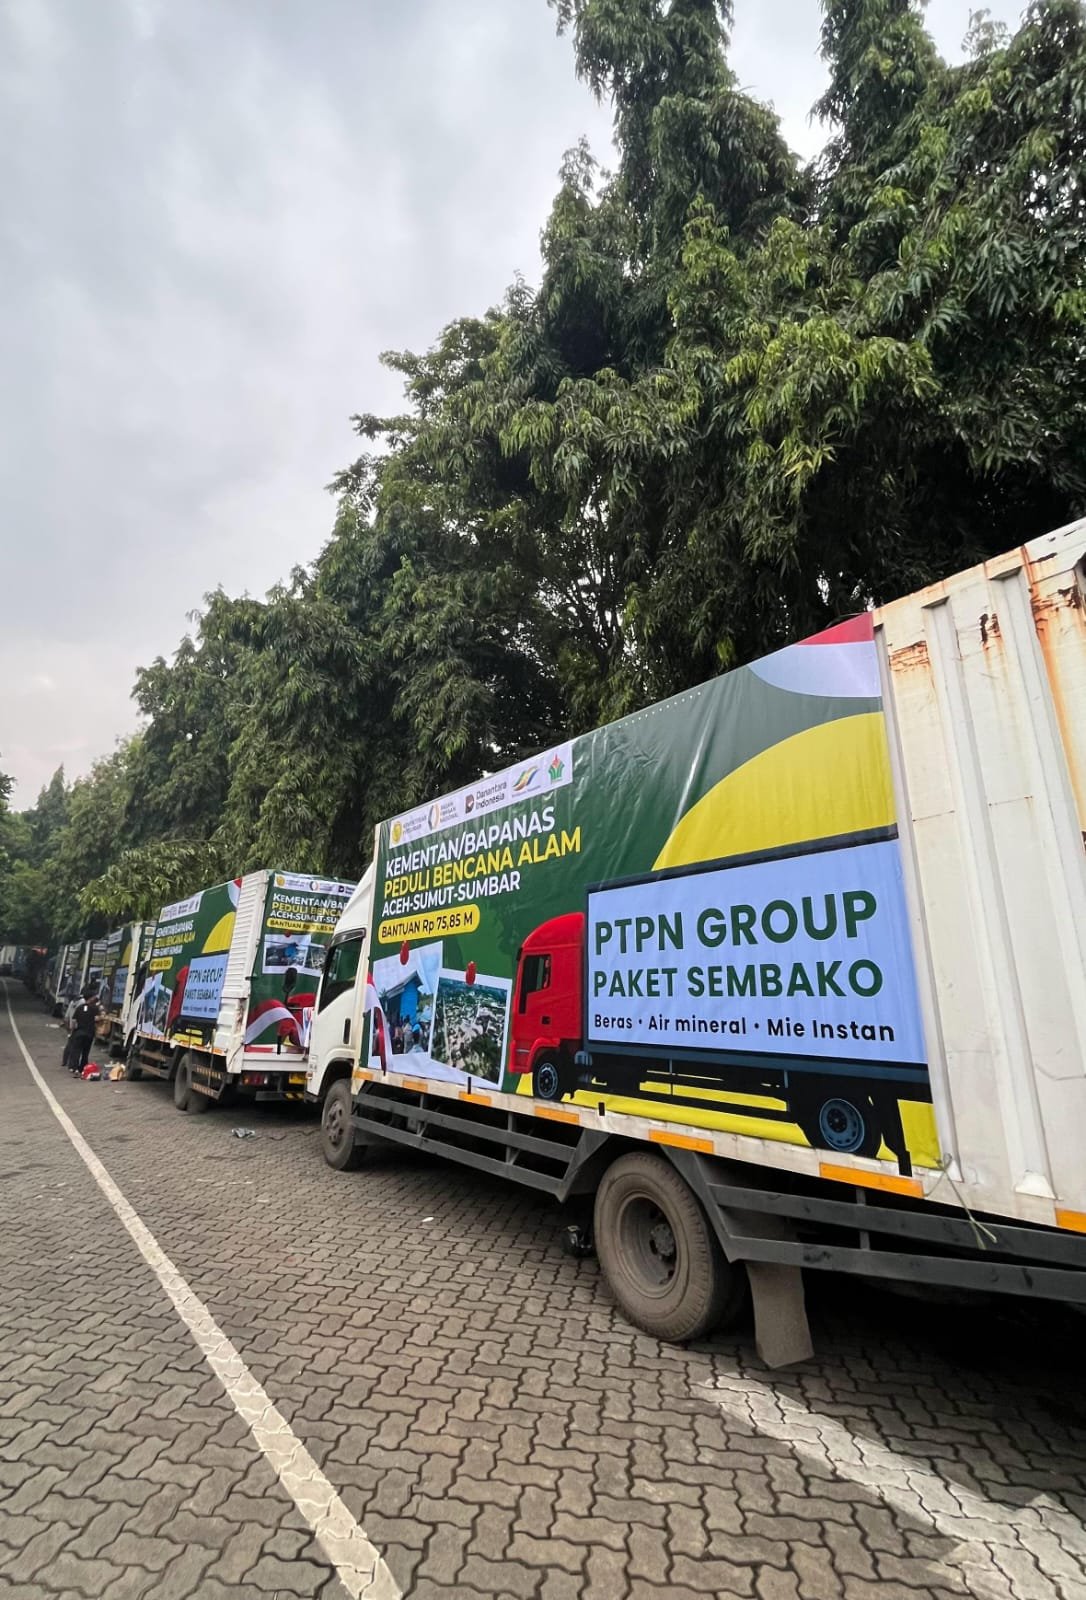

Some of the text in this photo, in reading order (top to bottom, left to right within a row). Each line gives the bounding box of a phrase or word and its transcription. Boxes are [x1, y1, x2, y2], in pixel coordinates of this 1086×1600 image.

[476, 781, 507, 800] Danantara
[476, 793, 505, 810] Indonesia
[385, 806, 556, 878] KEMENTAN/BAPANAS
[384, 826, 581, 899] PEDULI BENCANA ALAM
[381, 870, 521, 918] ACEH-SUMUT-SUMBAR
[381, 911, 473, 938] BANTUAN Rp 75,85 M
[594, 889, 878, 956] PTPN GROUP
[593, 958, 884, 998] PAKET SEMBAKO
[594, 1013, 896, 1042] Beras Air mineral Mie Instan
